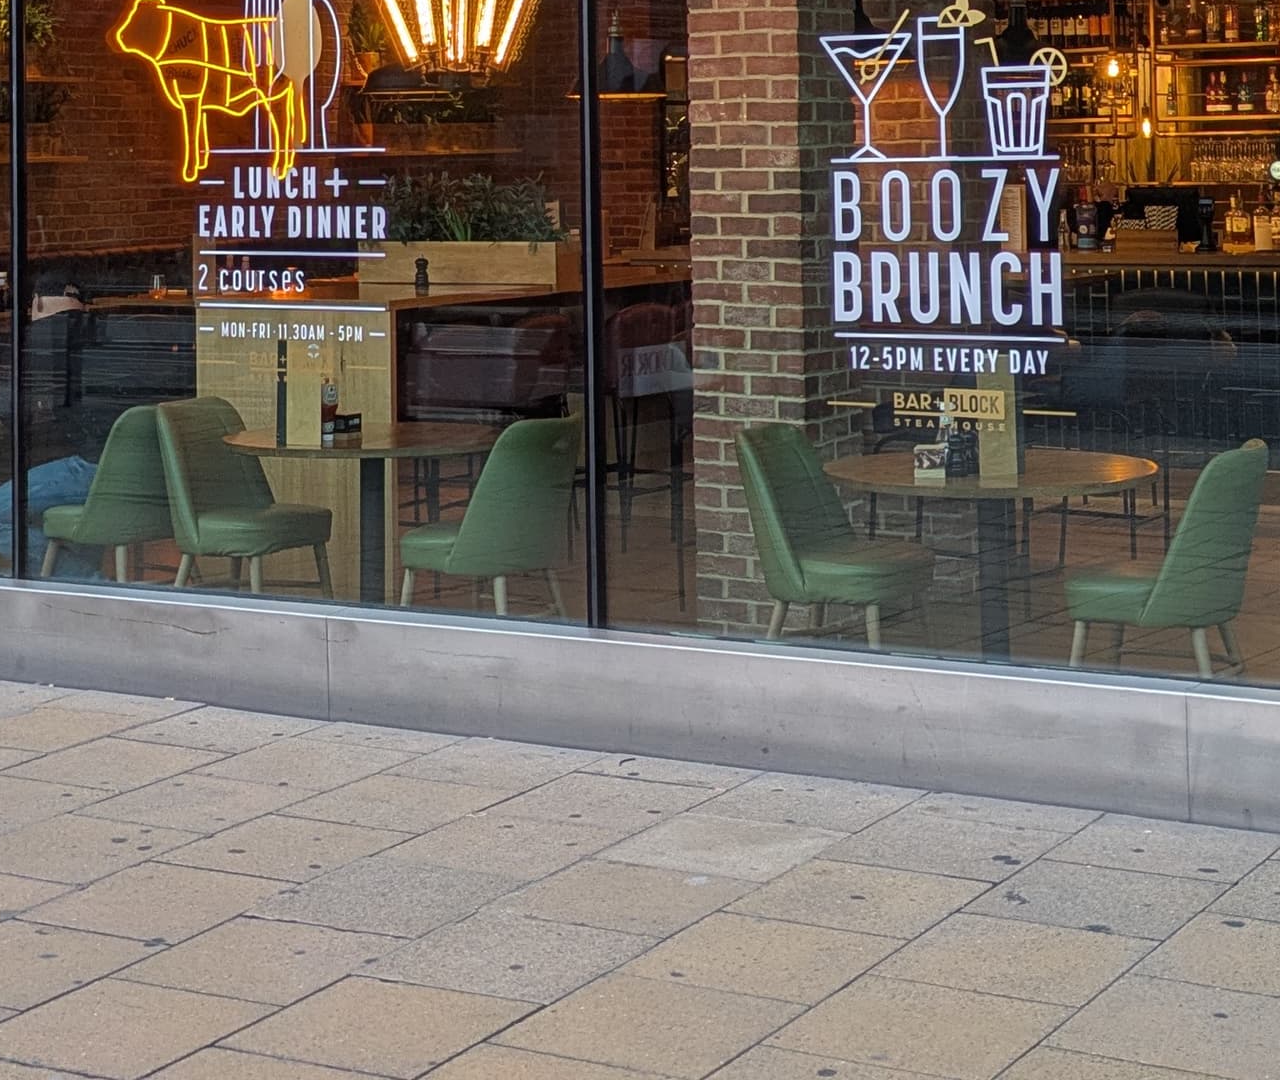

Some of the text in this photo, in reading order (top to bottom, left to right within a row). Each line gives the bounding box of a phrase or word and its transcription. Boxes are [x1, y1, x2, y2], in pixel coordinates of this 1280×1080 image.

[234, 166, 316, 199] LUNCH
[833, 168, 1060, 242] BOOZY
[199, 205, 386, 239] EARLY DINNER
[198, 264, 209, 291] 2
[833, 251, 1063, 326] BRUNCH
[338, 325, 363, 342] 5PM
[850, 346, 1049, 375] 12-5PM EVERY DAY
[949, 393, 1000, 415] BLOCK
